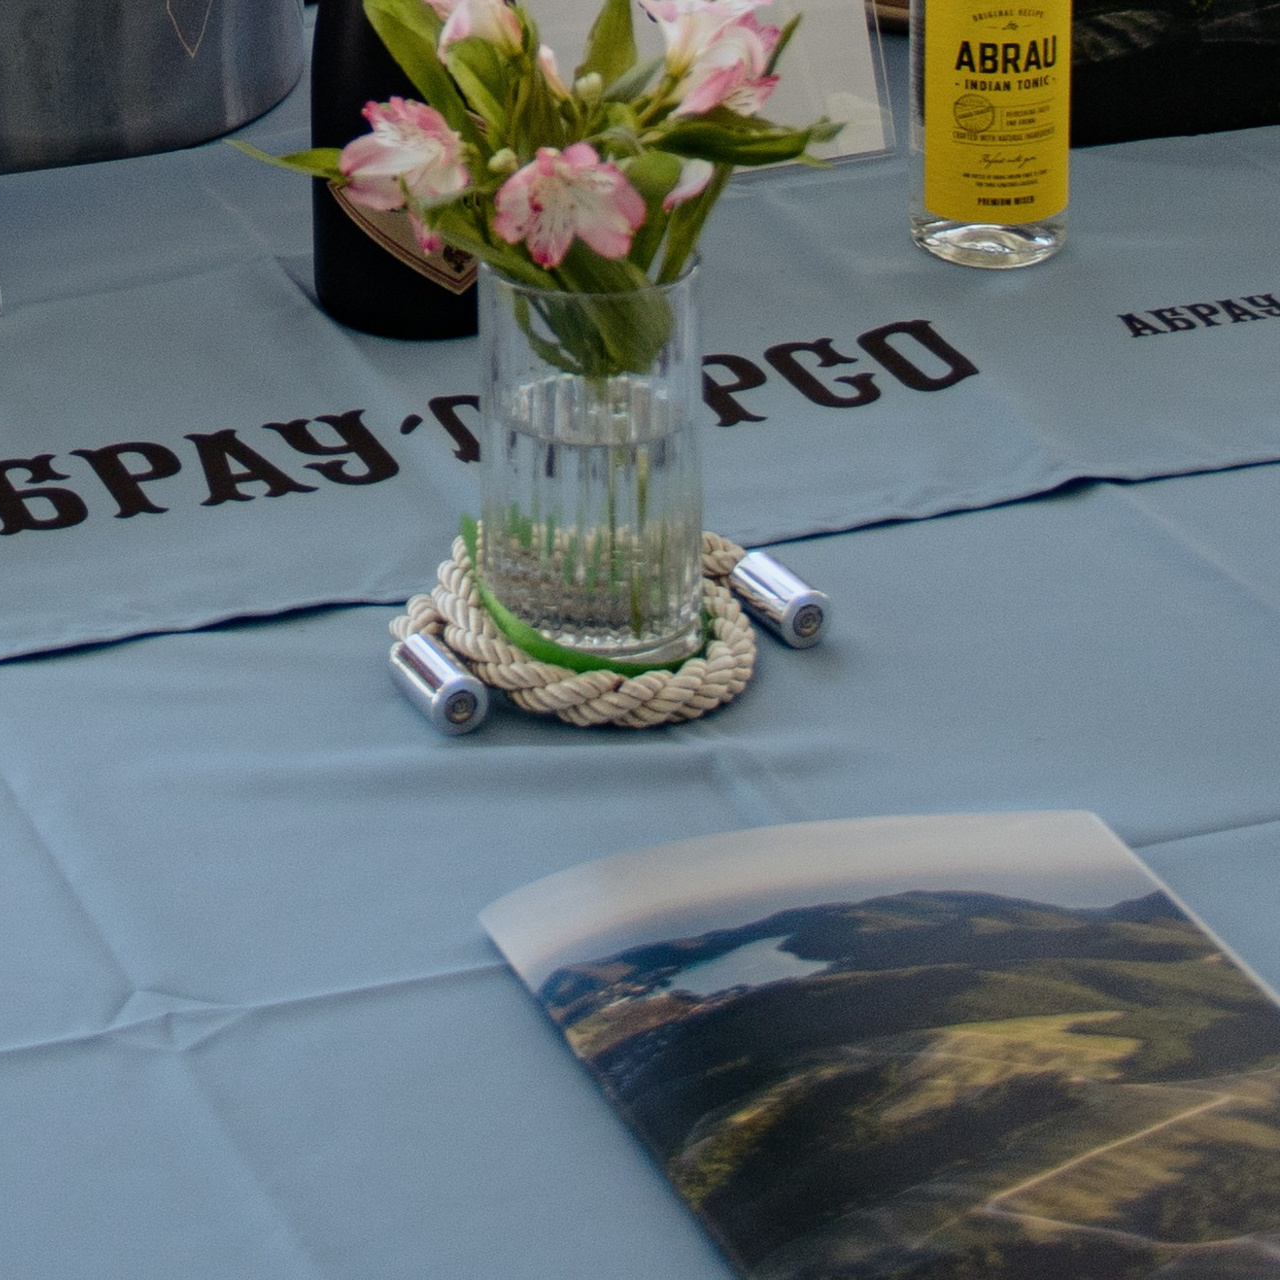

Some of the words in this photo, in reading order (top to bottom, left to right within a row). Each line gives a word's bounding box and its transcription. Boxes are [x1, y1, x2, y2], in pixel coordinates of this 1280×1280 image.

[955, 35, 1057, 74] ABRAU
[965, 78, 1011, 91] INDIAN
[1017, 75, 1050, 91] TONIC
